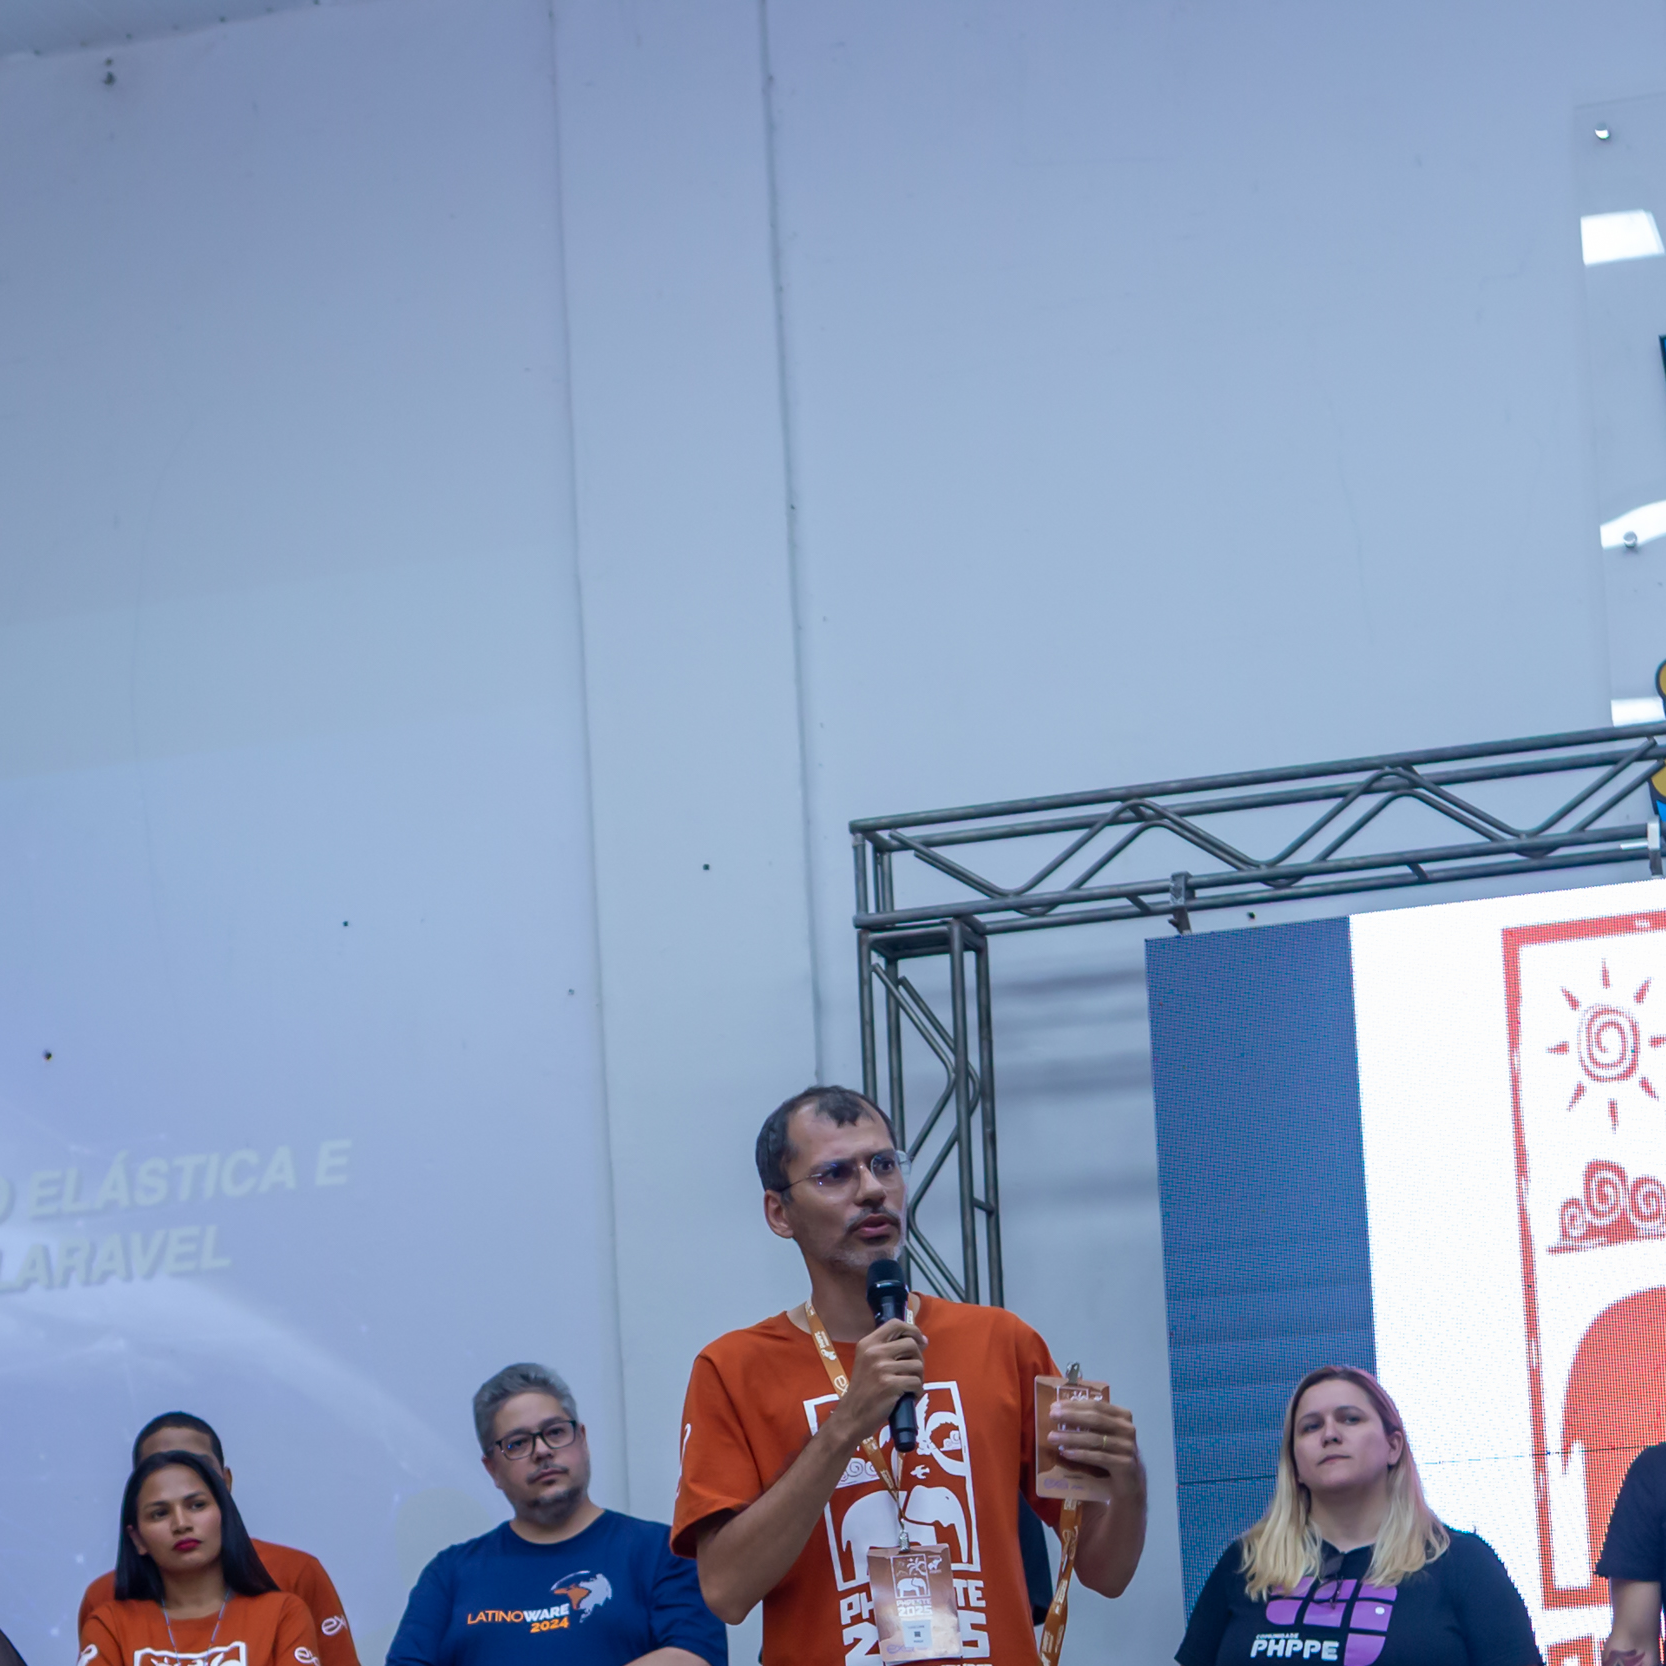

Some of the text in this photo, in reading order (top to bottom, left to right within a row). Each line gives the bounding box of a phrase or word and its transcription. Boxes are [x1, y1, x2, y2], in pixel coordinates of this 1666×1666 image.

[29, 1146, 297, 1220] ELÁSTICA
[315, 1139, 352, 1187] E
[897, 1605, 933, 1616] 2025
[530, 1616, 569, 1633] 2024
[1250, 1639, 1339, 1661] PHPPE
